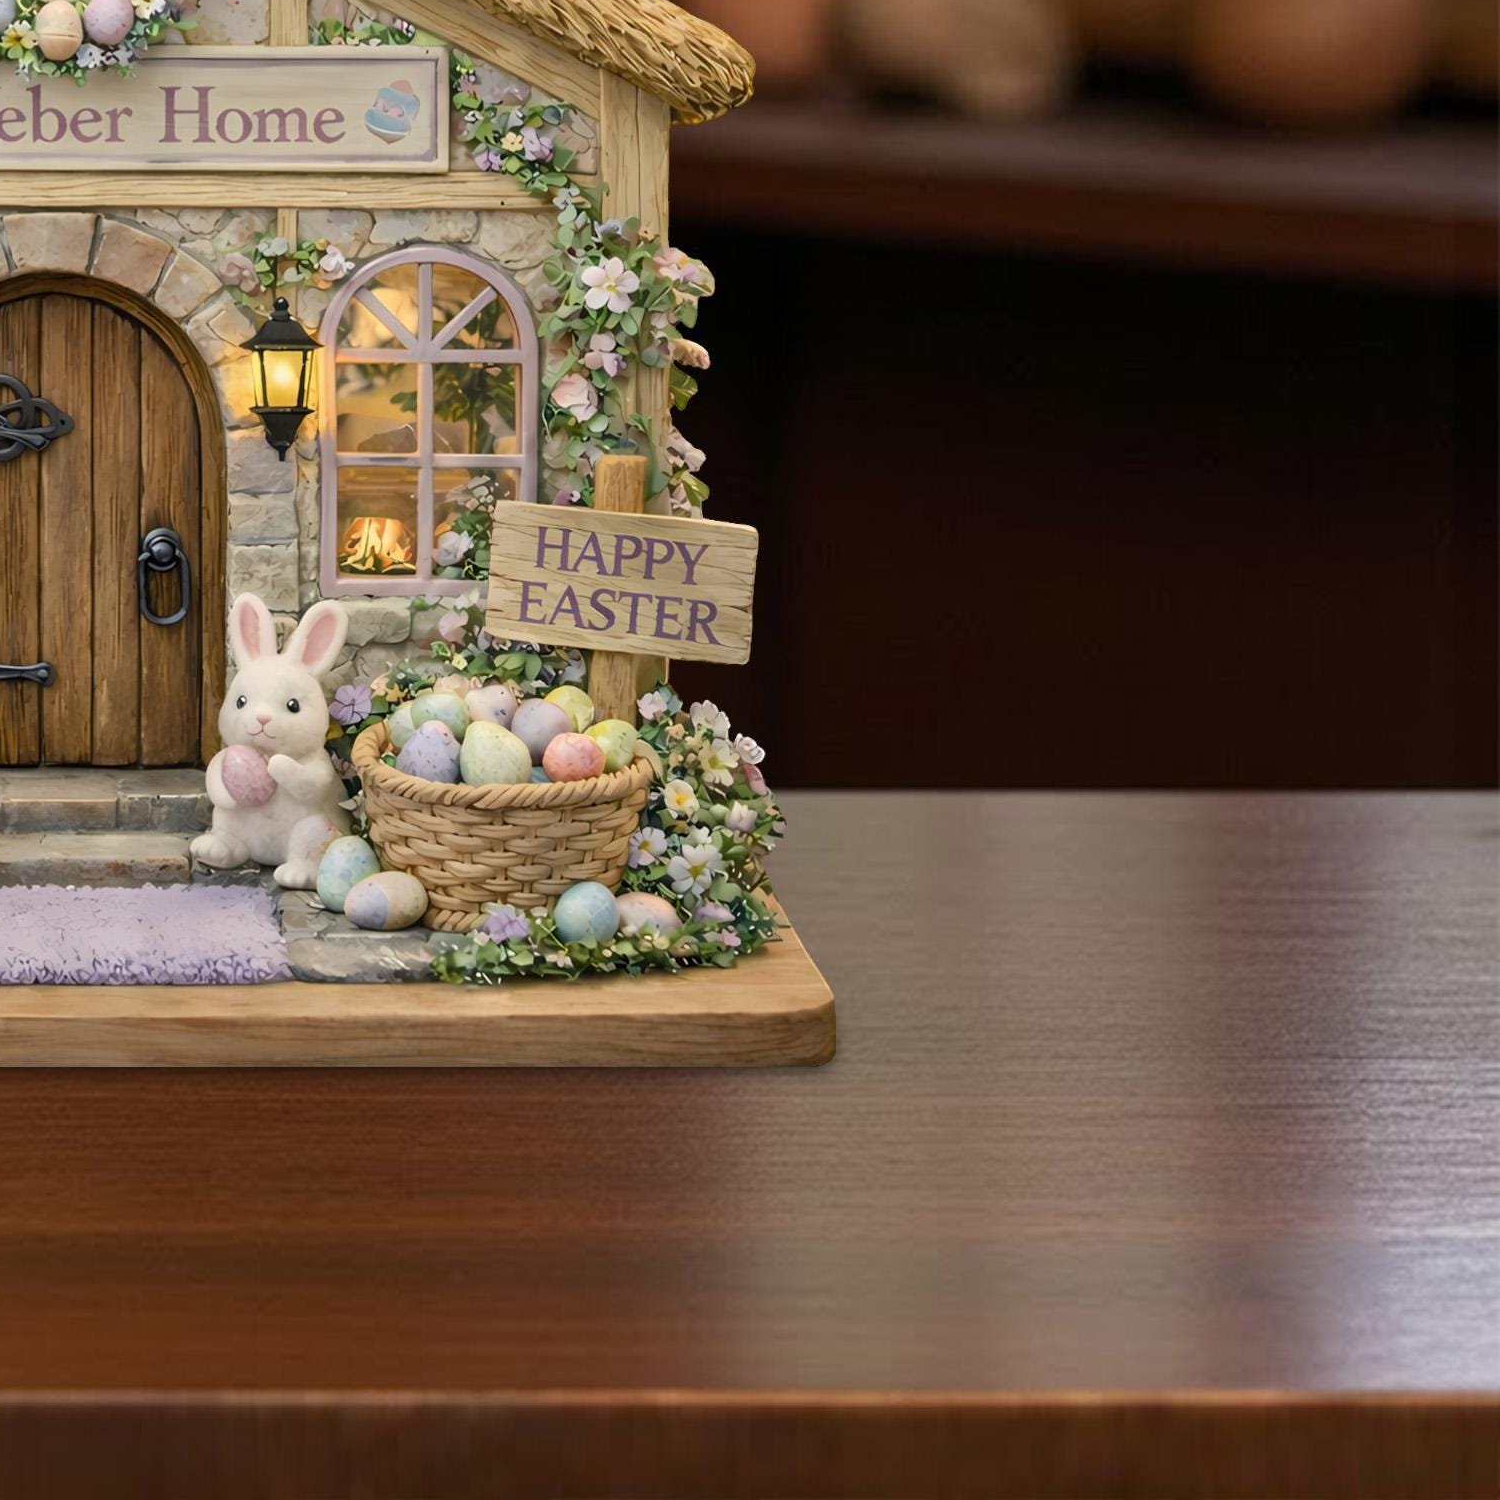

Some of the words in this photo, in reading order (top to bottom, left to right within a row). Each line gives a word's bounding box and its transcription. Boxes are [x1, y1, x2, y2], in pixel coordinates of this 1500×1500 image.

[158, 85, 346, 143] Home
[534, 526, 711, 586] HAPPY
[518, 581, 723, 646] EASTER
